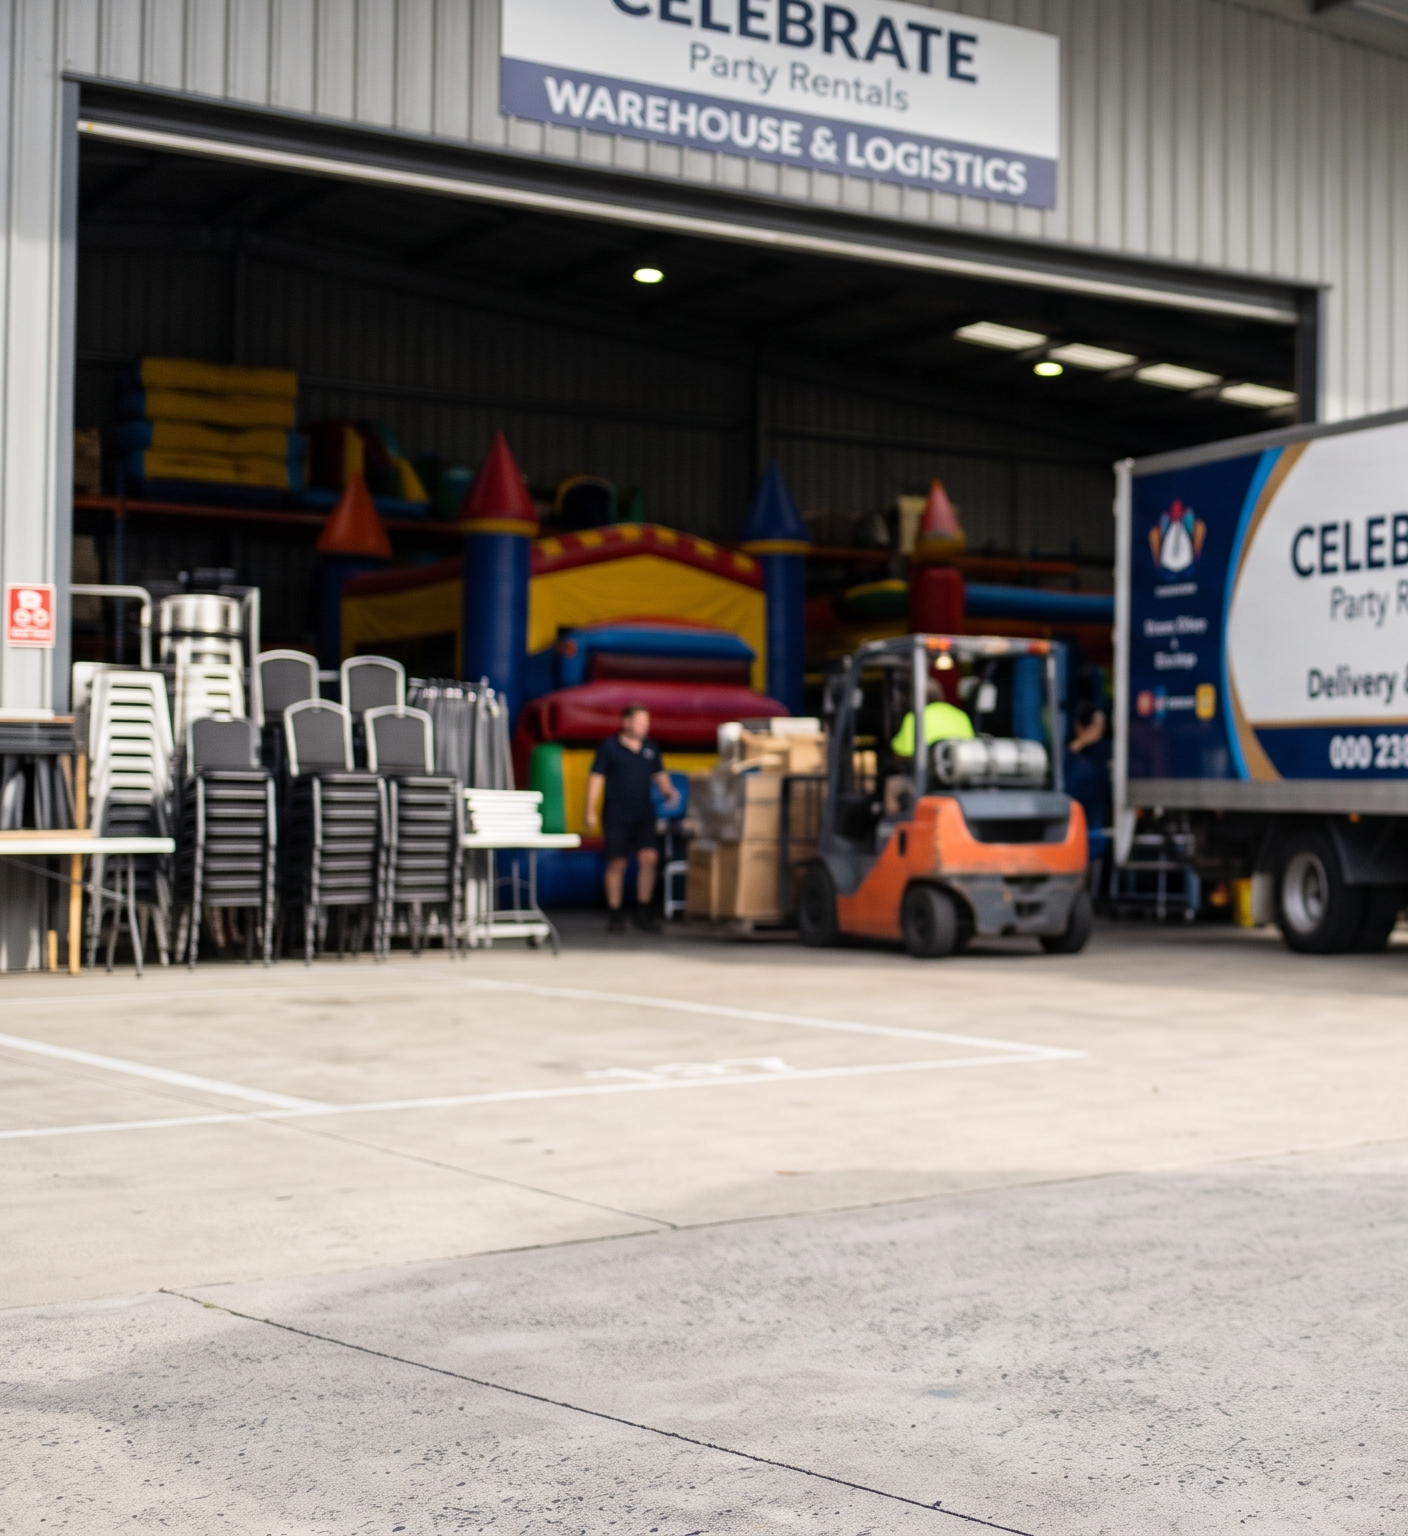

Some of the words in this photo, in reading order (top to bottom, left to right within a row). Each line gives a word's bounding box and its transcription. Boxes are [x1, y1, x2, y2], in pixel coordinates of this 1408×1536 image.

[688, 42, 777, 94] Party
[789, 61, 909, 112] Rentals
[544, 76, 803, 157] WAREHOUSE
[809, 128, 839, 162] &
[845, 131, 1027, 196] LOGISTICS
[1330, 585, 1390, 629] Party
[1307, 664, 1397, 705] Delivery
[1329, 734, 1373, 770] 000
